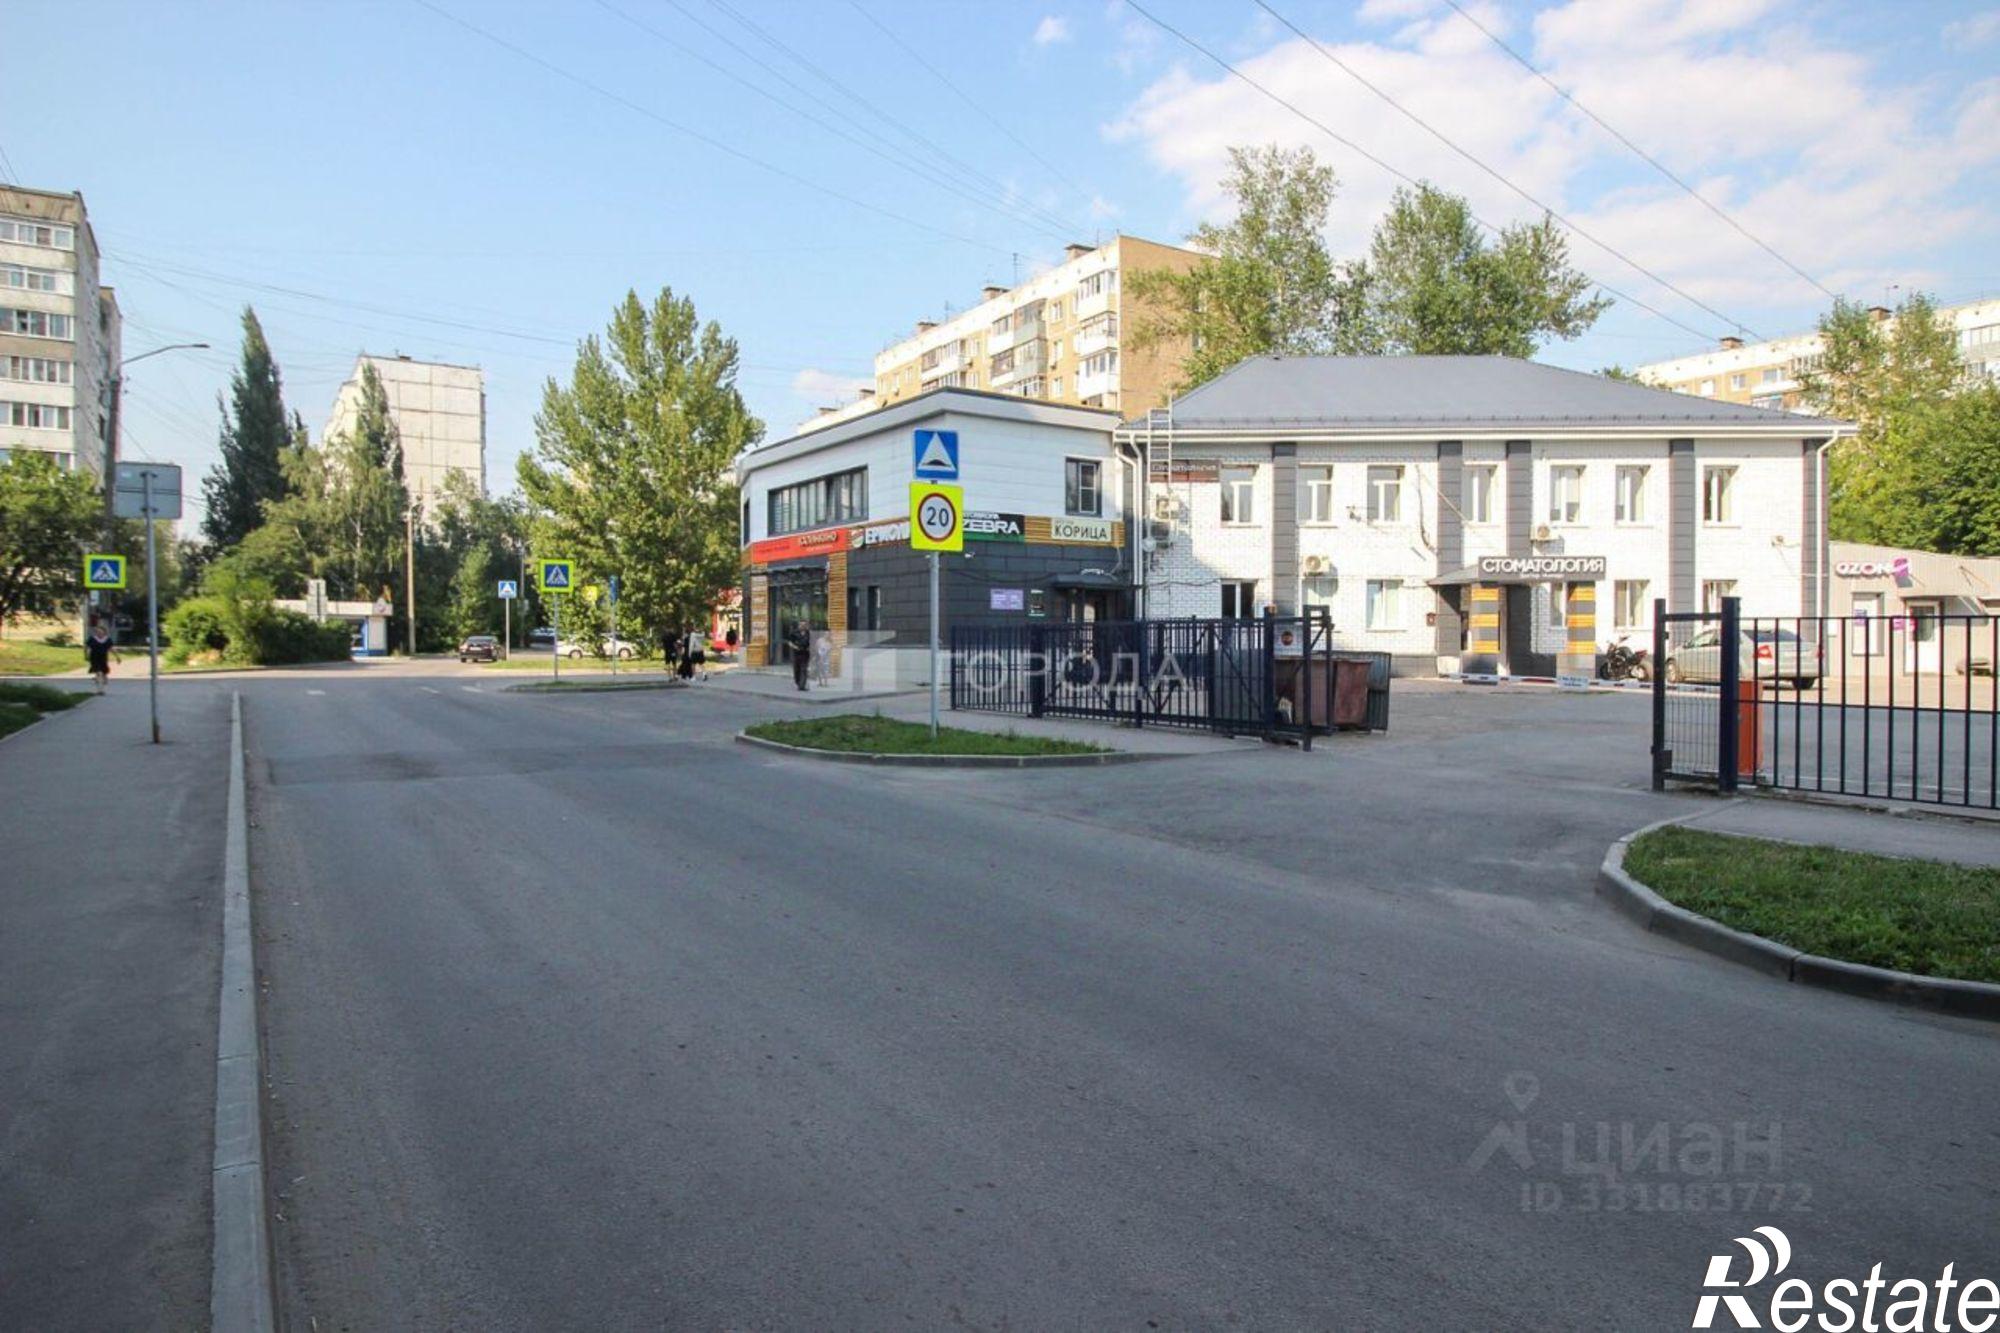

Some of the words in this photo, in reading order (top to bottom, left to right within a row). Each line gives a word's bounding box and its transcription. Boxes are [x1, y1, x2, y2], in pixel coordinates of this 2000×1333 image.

[926, 506, 950, 528] 20
[1054, 525, 1108, 540] КОРИЦА
[1482, 558, 1604, 573] СТОМАТОЛОГИЯ
